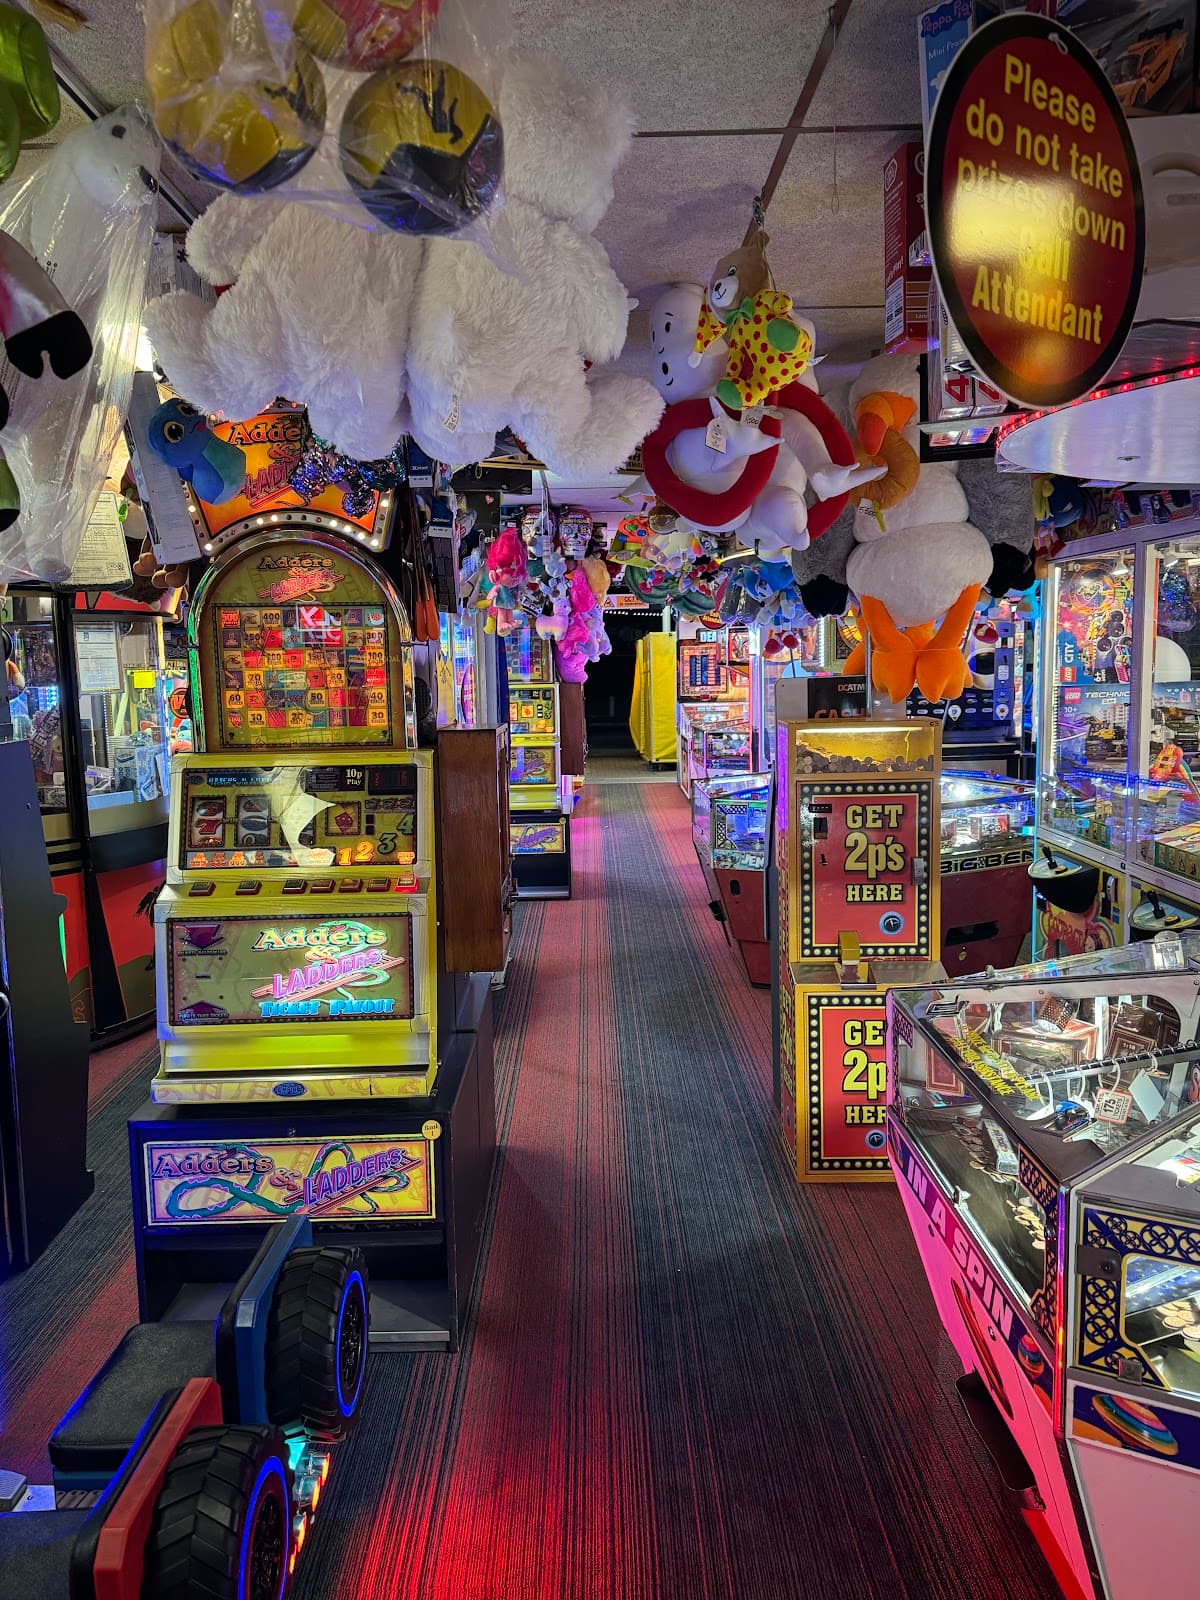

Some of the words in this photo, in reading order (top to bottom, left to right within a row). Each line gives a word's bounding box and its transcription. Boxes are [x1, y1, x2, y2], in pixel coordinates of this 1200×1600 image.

[1005, 54, 1096, 134] Please
[966, 99, 1004, 146] do
[1015, 123, 1061, 173] not
[1070, 144, 1123, 198] take
[957, 156, 1049, 216] prizes
[1060, 193, 1126, 251] down
[1019, 226, 1071, 283] Call
[971, 265, 1103, 344] Attendant
[228, 422, 301, 445] Adde
[257, 556, 336, 571] Adders
[263, 612, 280, 620] 400
[1064, 642, 1075, 663] CITY
[310, 692, 323, 701] 50
[370, 692, 384, 700] 40
[837, 683, 865, 692] DCATM
[1084, 690, 1131, 699] TECHNIC
[371, 711, 384, 720] 30
[345, 768, 363, 778] 10p
[396, 814, 414, 835] 4
[846, 804, 904, 829] GET
[355, 841, 375, 862] 2
[377, 832, 398, 855] 3
[339, 847, 352, 866] 1
[844, 832, 905, 879] 2p's
[846, 884, 904, 902] HERE
[251, 927, 388, 951] Adders
[304, 945, 341, 966] &
[272, 949, 388, 1000] LADDERS
[844, 1020, 886, 1047] GE
[842, 1049, 887, 1100] 2p
[844, 1105, 886, 1125] HER
[1103, 1098, 1116, 1113] 175
[152, 1152, 275, 1180] Adders
[302, 1147, 408, 1206] LADDERS
[268, 1167, 302, 1191] &
[907, 1164, 929, 1202] IN
[930, 1200, 946, 1235] A
[951, 1226, 1014, 1341] SPIN
